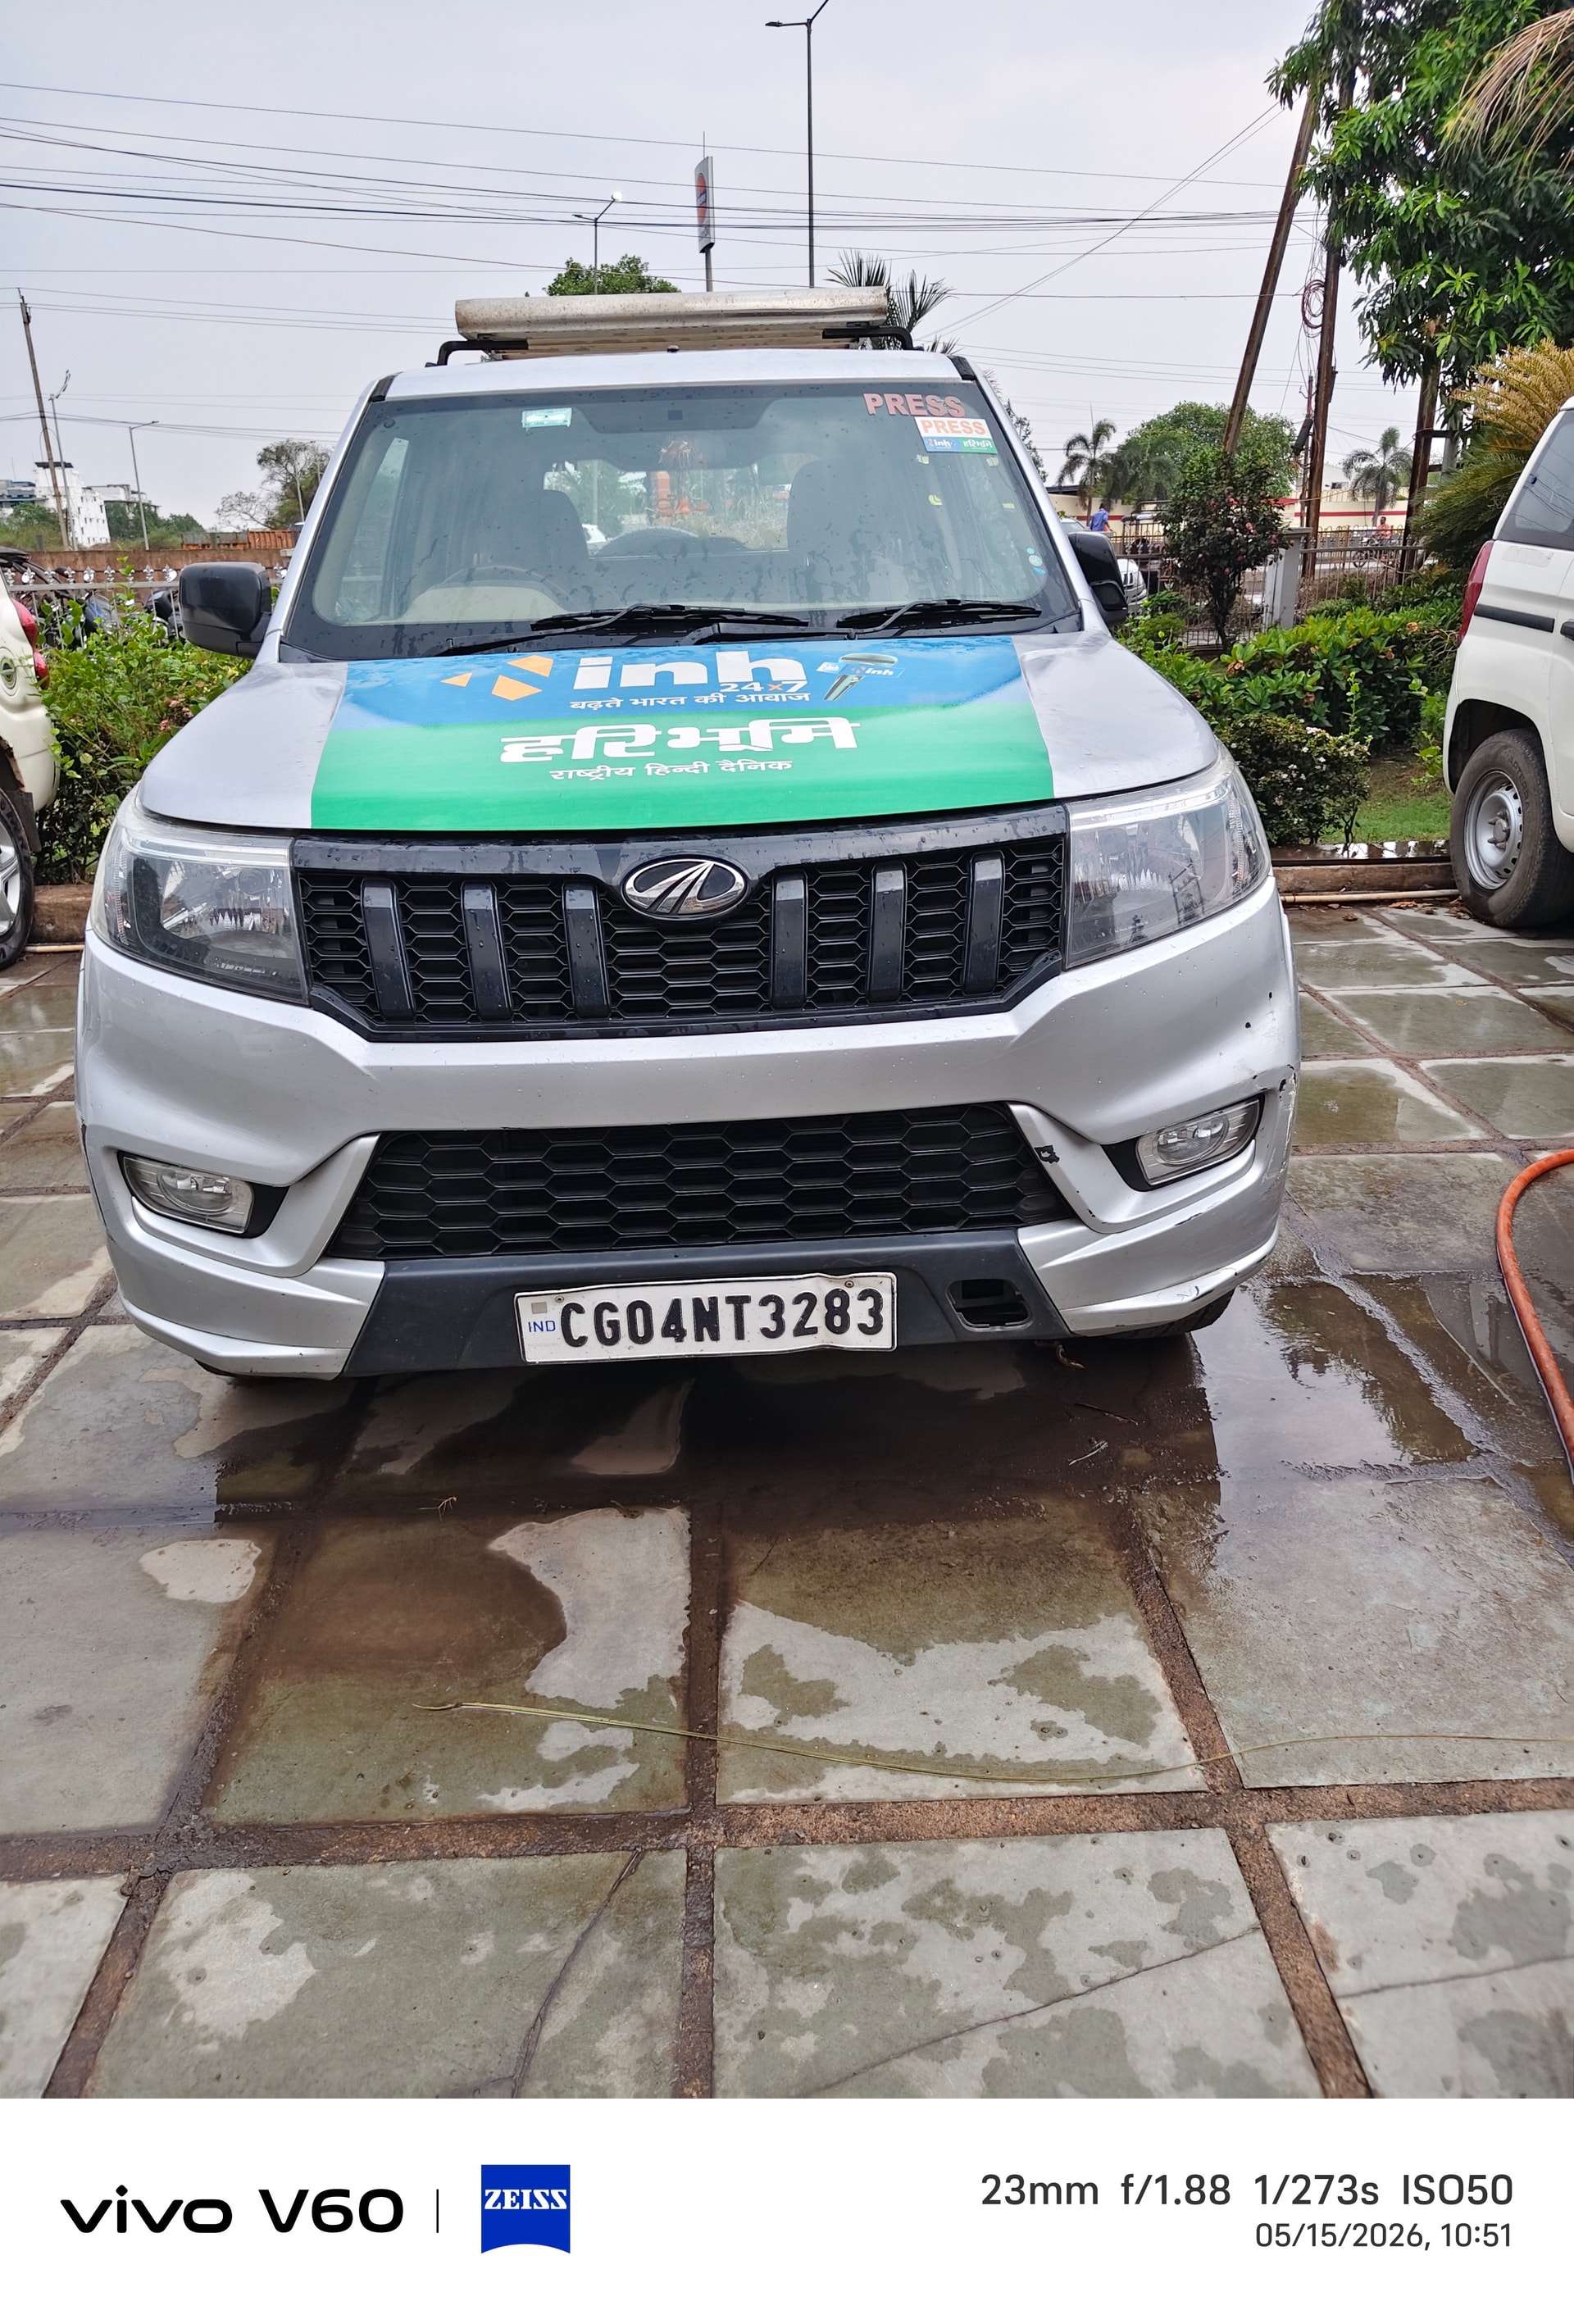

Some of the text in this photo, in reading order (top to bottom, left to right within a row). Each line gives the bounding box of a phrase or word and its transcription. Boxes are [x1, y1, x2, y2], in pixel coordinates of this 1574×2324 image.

[863, 393, 966, 417] PRESS
[921, 419, 986, 435] PRESS
[570, 693, 811, 711] बढ़ते भारत की आवाज
[500, 716, 861, 763] हरिभूमि
[549, 759, 793, 781] राष्ट्रीय हिन्दी दैनिक
[528, 1288, 884, 1347] IND CG04NT3283
